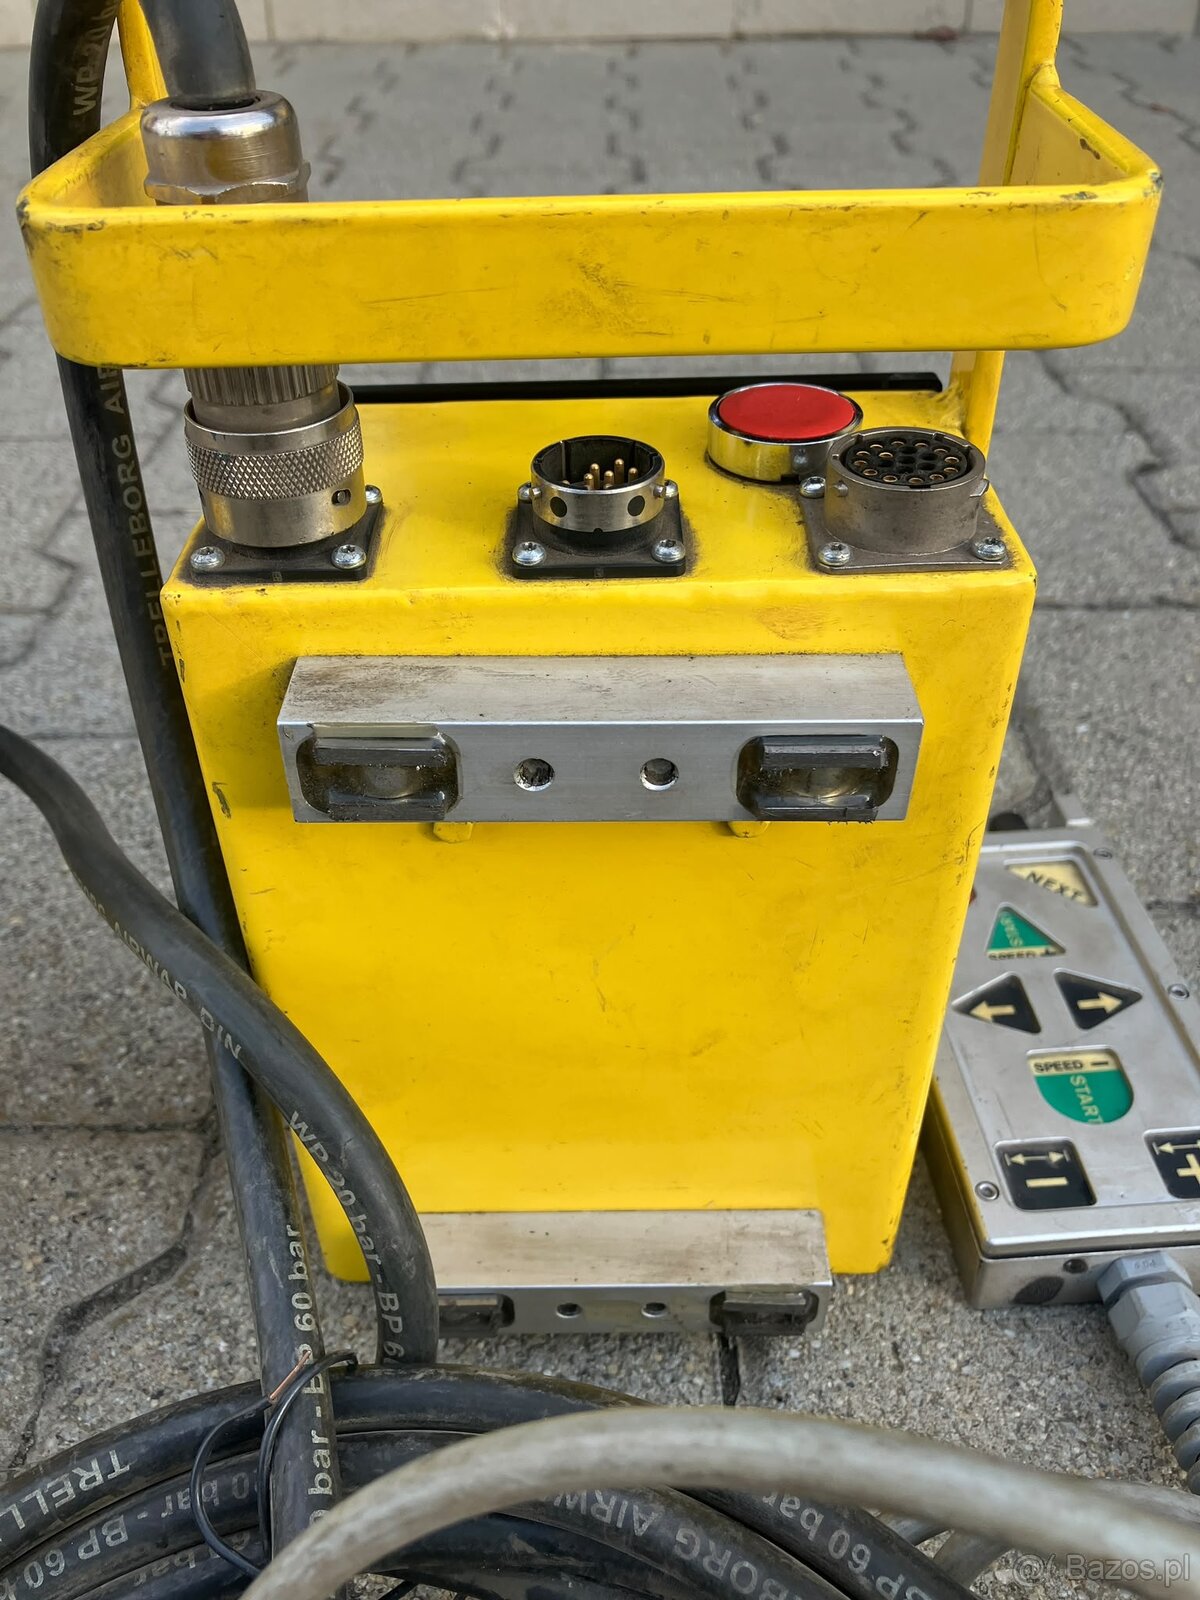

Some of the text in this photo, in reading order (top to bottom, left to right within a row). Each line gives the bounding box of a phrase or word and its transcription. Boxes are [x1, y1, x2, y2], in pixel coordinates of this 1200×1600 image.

[201, 1007, 242, 1059] DIN
[1033, 1060, 1084, 1072] SPEED
[1070, 1075, 1104, 1124] START
[290, 1111, 329, 1162] WP
[351, 1214, 382, 1265] bar
[377, 1292, 403, 1334] BP
[287, 1224, 309, 1281] bar
[291, 1292, 317, 1332] 60
[307, 1430, 333, 1495] bar
[78, 1515, 128, 1561] BP
[827, 1529, 871, 1574] 60
[24, 1549, 65, 1589] 60
[673, 1527, 804, 1600] BORG
